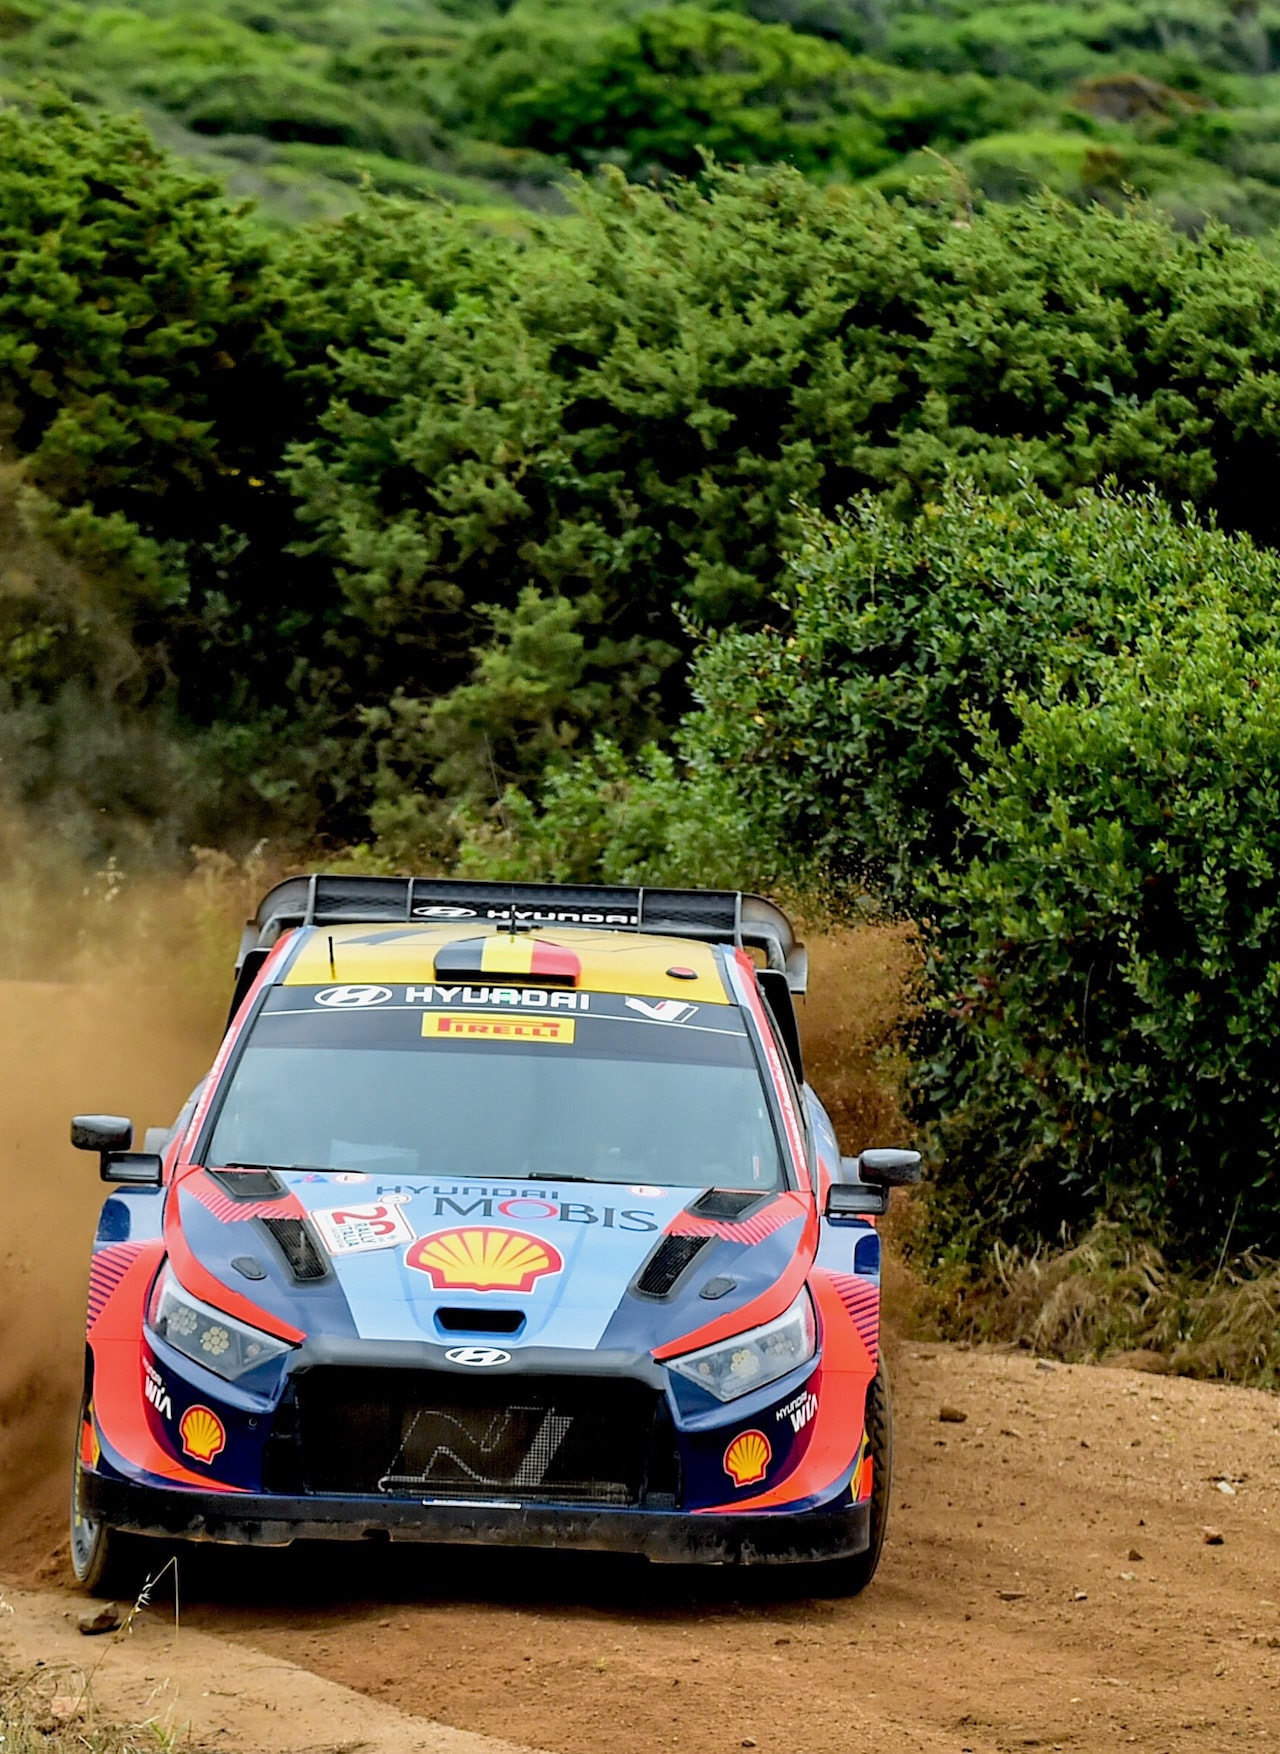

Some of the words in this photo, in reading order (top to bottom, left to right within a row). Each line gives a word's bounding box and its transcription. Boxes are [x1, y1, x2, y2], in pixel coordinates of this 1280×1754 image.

[487, 909, 638, 925] HYUNDAI
[405, 985, 590, 1011] HYUNDAI
[438, 1017, 561, 1037] PIRELLI
[376, 1185, 558, 1199] HYUNDAI
[433, 1196, 658, 1232] MOBIS
